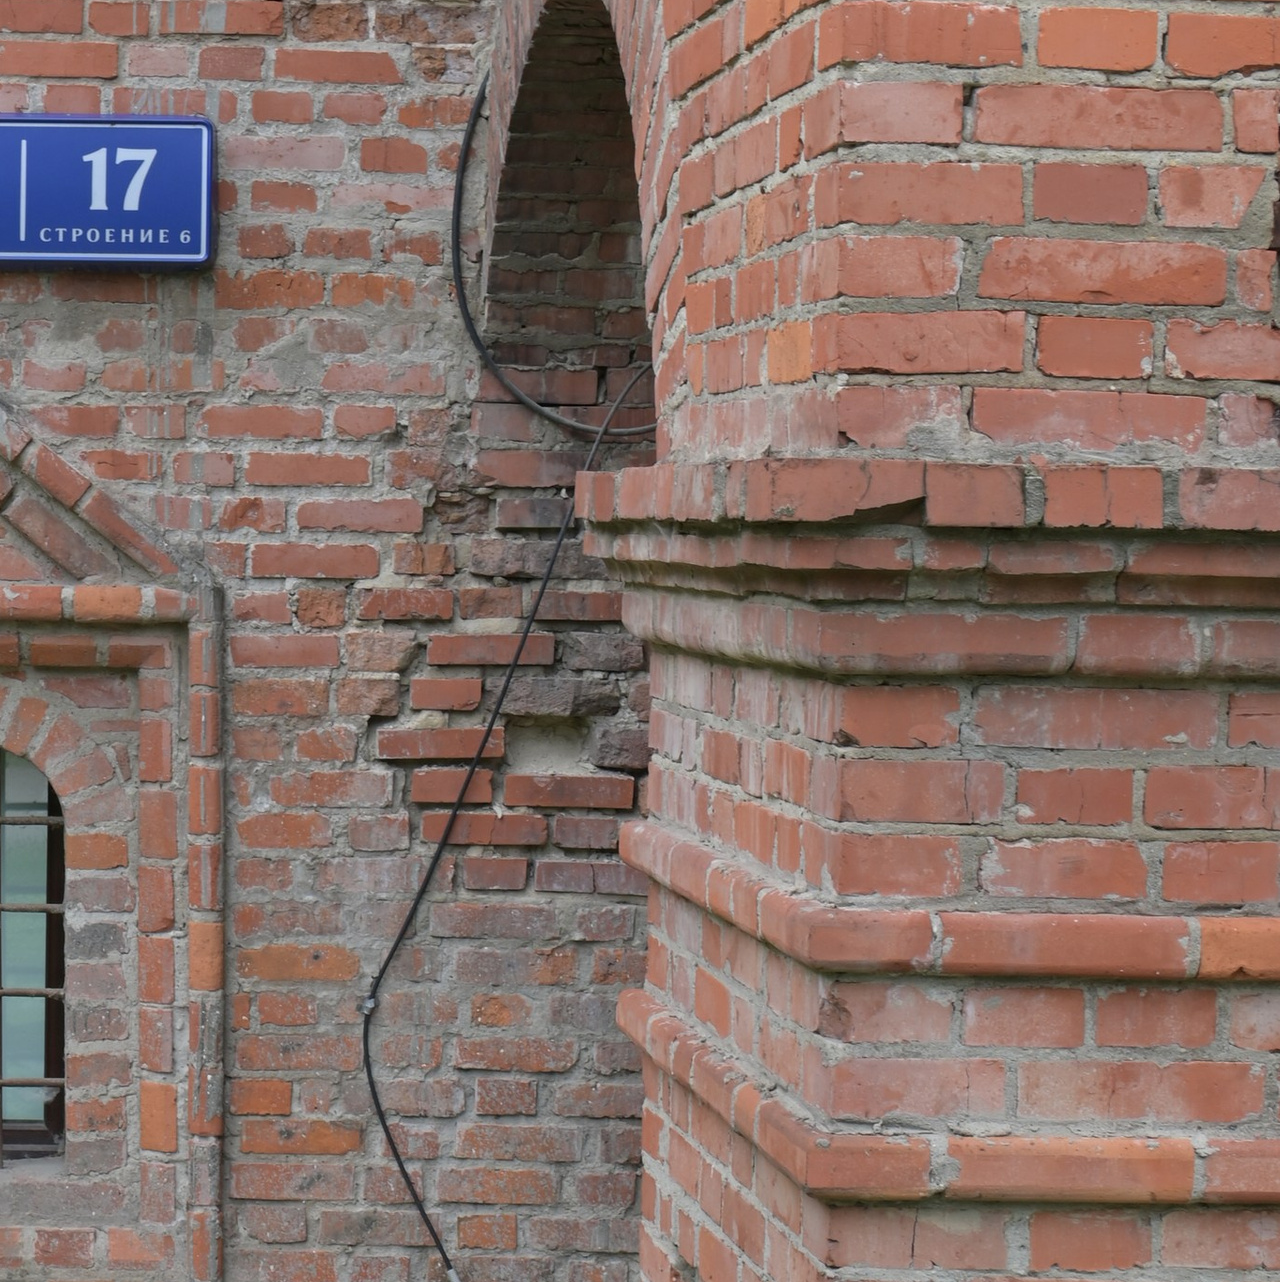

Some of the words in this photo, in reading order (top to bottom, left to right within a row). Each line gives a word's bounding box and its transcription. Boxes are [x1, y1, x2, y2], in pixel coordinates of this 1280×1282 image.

[81, 146, 158, 212] 17
[39, 227, 170, 244] СТРОЕНИЕ
[179, 229, 192, 244] 6
